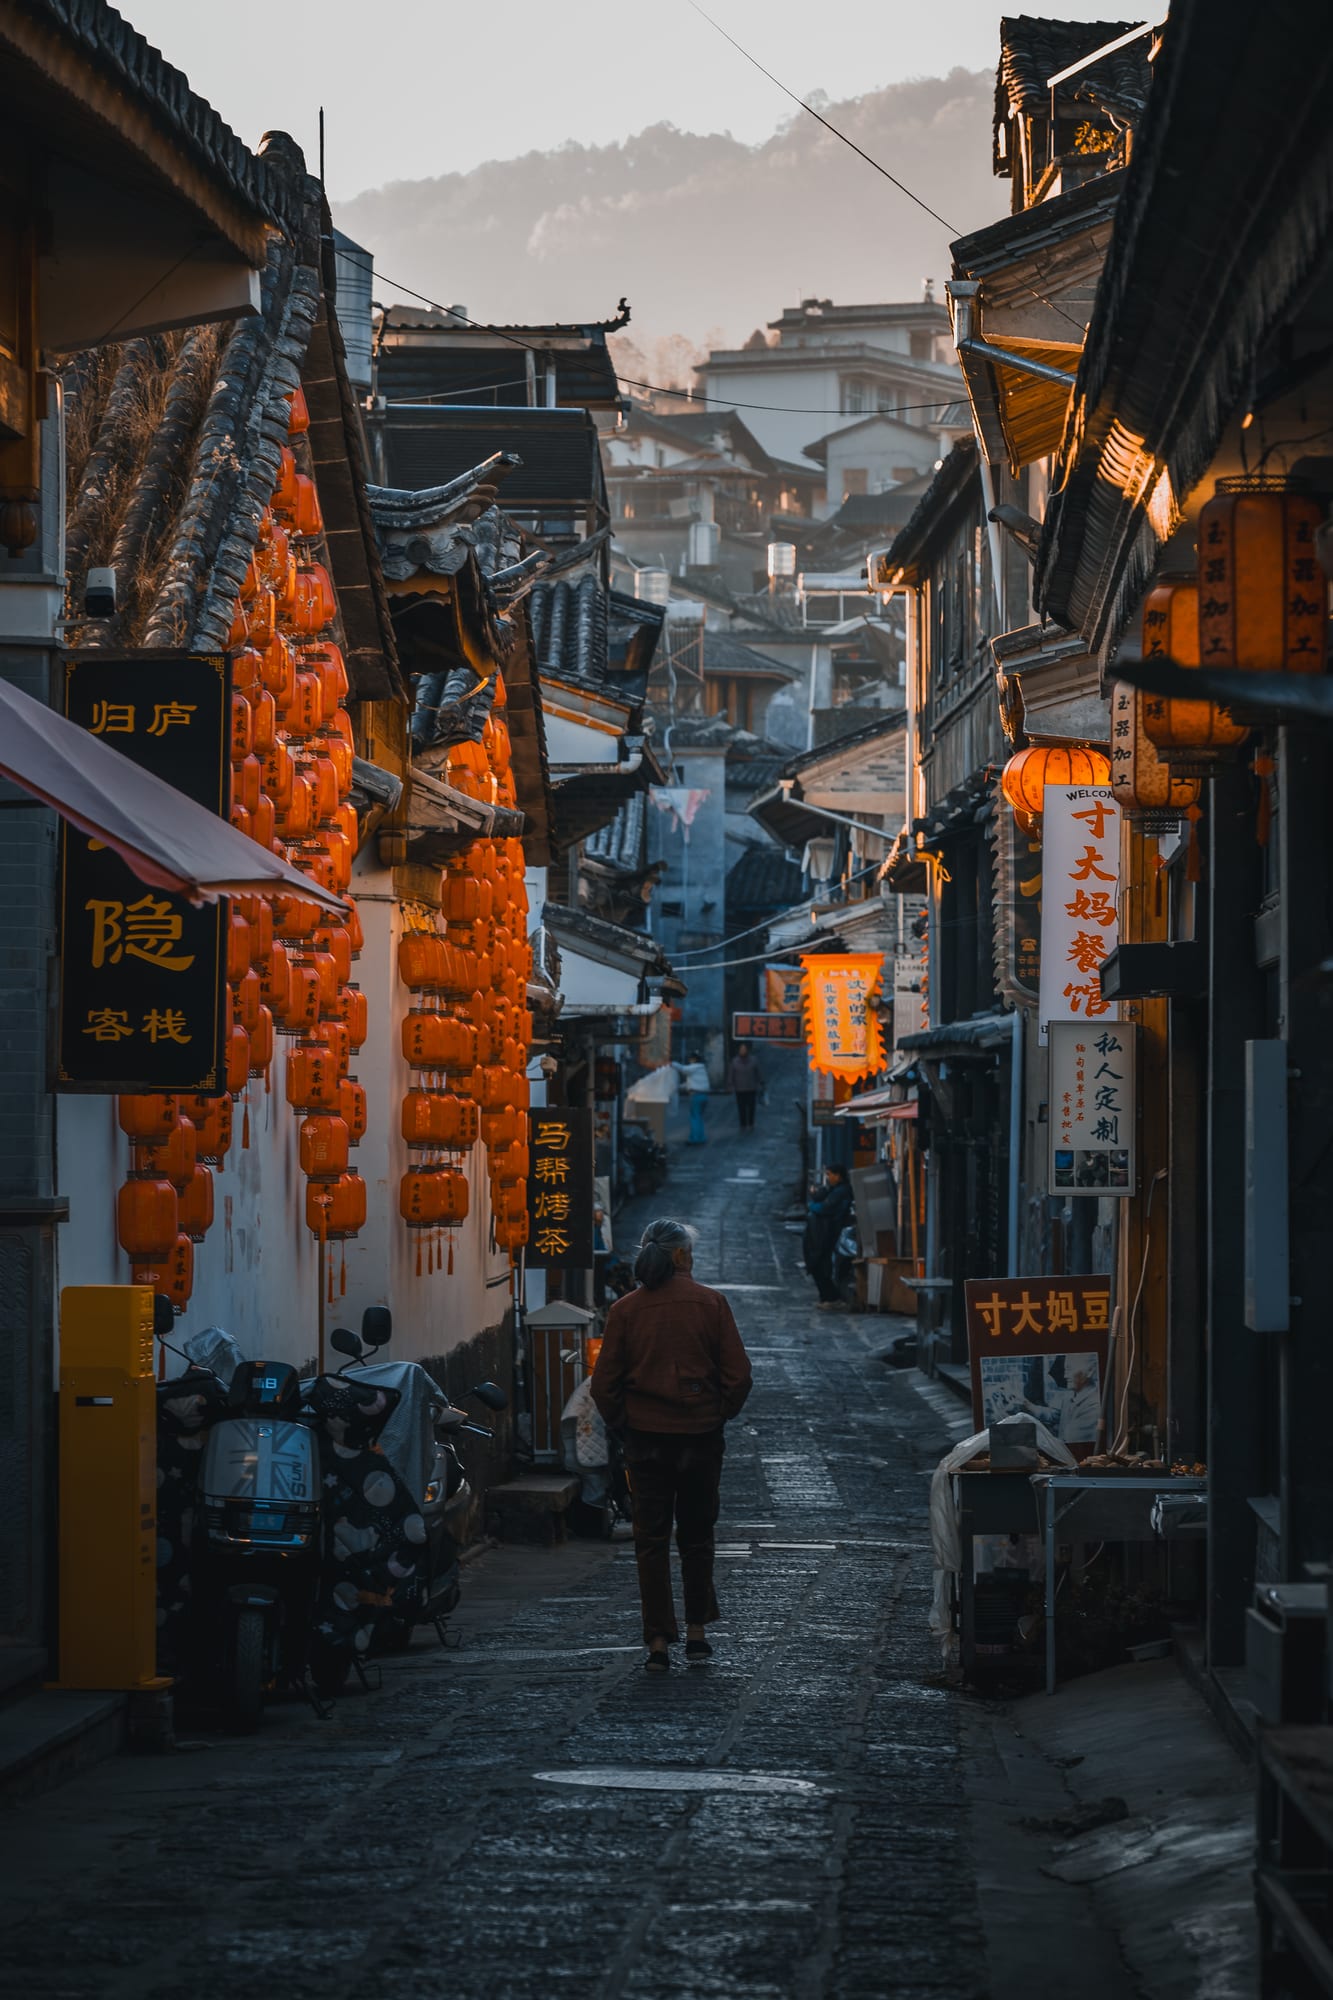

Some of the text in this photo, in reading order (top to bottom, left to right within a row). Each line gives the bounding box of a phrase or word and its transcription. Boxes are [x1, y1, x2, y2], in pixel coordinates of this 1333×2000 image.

[1203, 522, 1228, 655] 玉器加工
[88, 699, 198, 737] 归庐
[1114, 695, 1132, 786] 玉器加工
[84, 838, 196, 972] 隐
[1063, 800, 1117, 1017] 寸大妈餐馆
[81, 1007, 193, 1045] 客栈
[1090, 1032, 1123, 1145] 私人定制
[533, 1121, 573, 1257] 马帮烤茶
[975, 1290, 1109, 1336] 寸大妈豆
